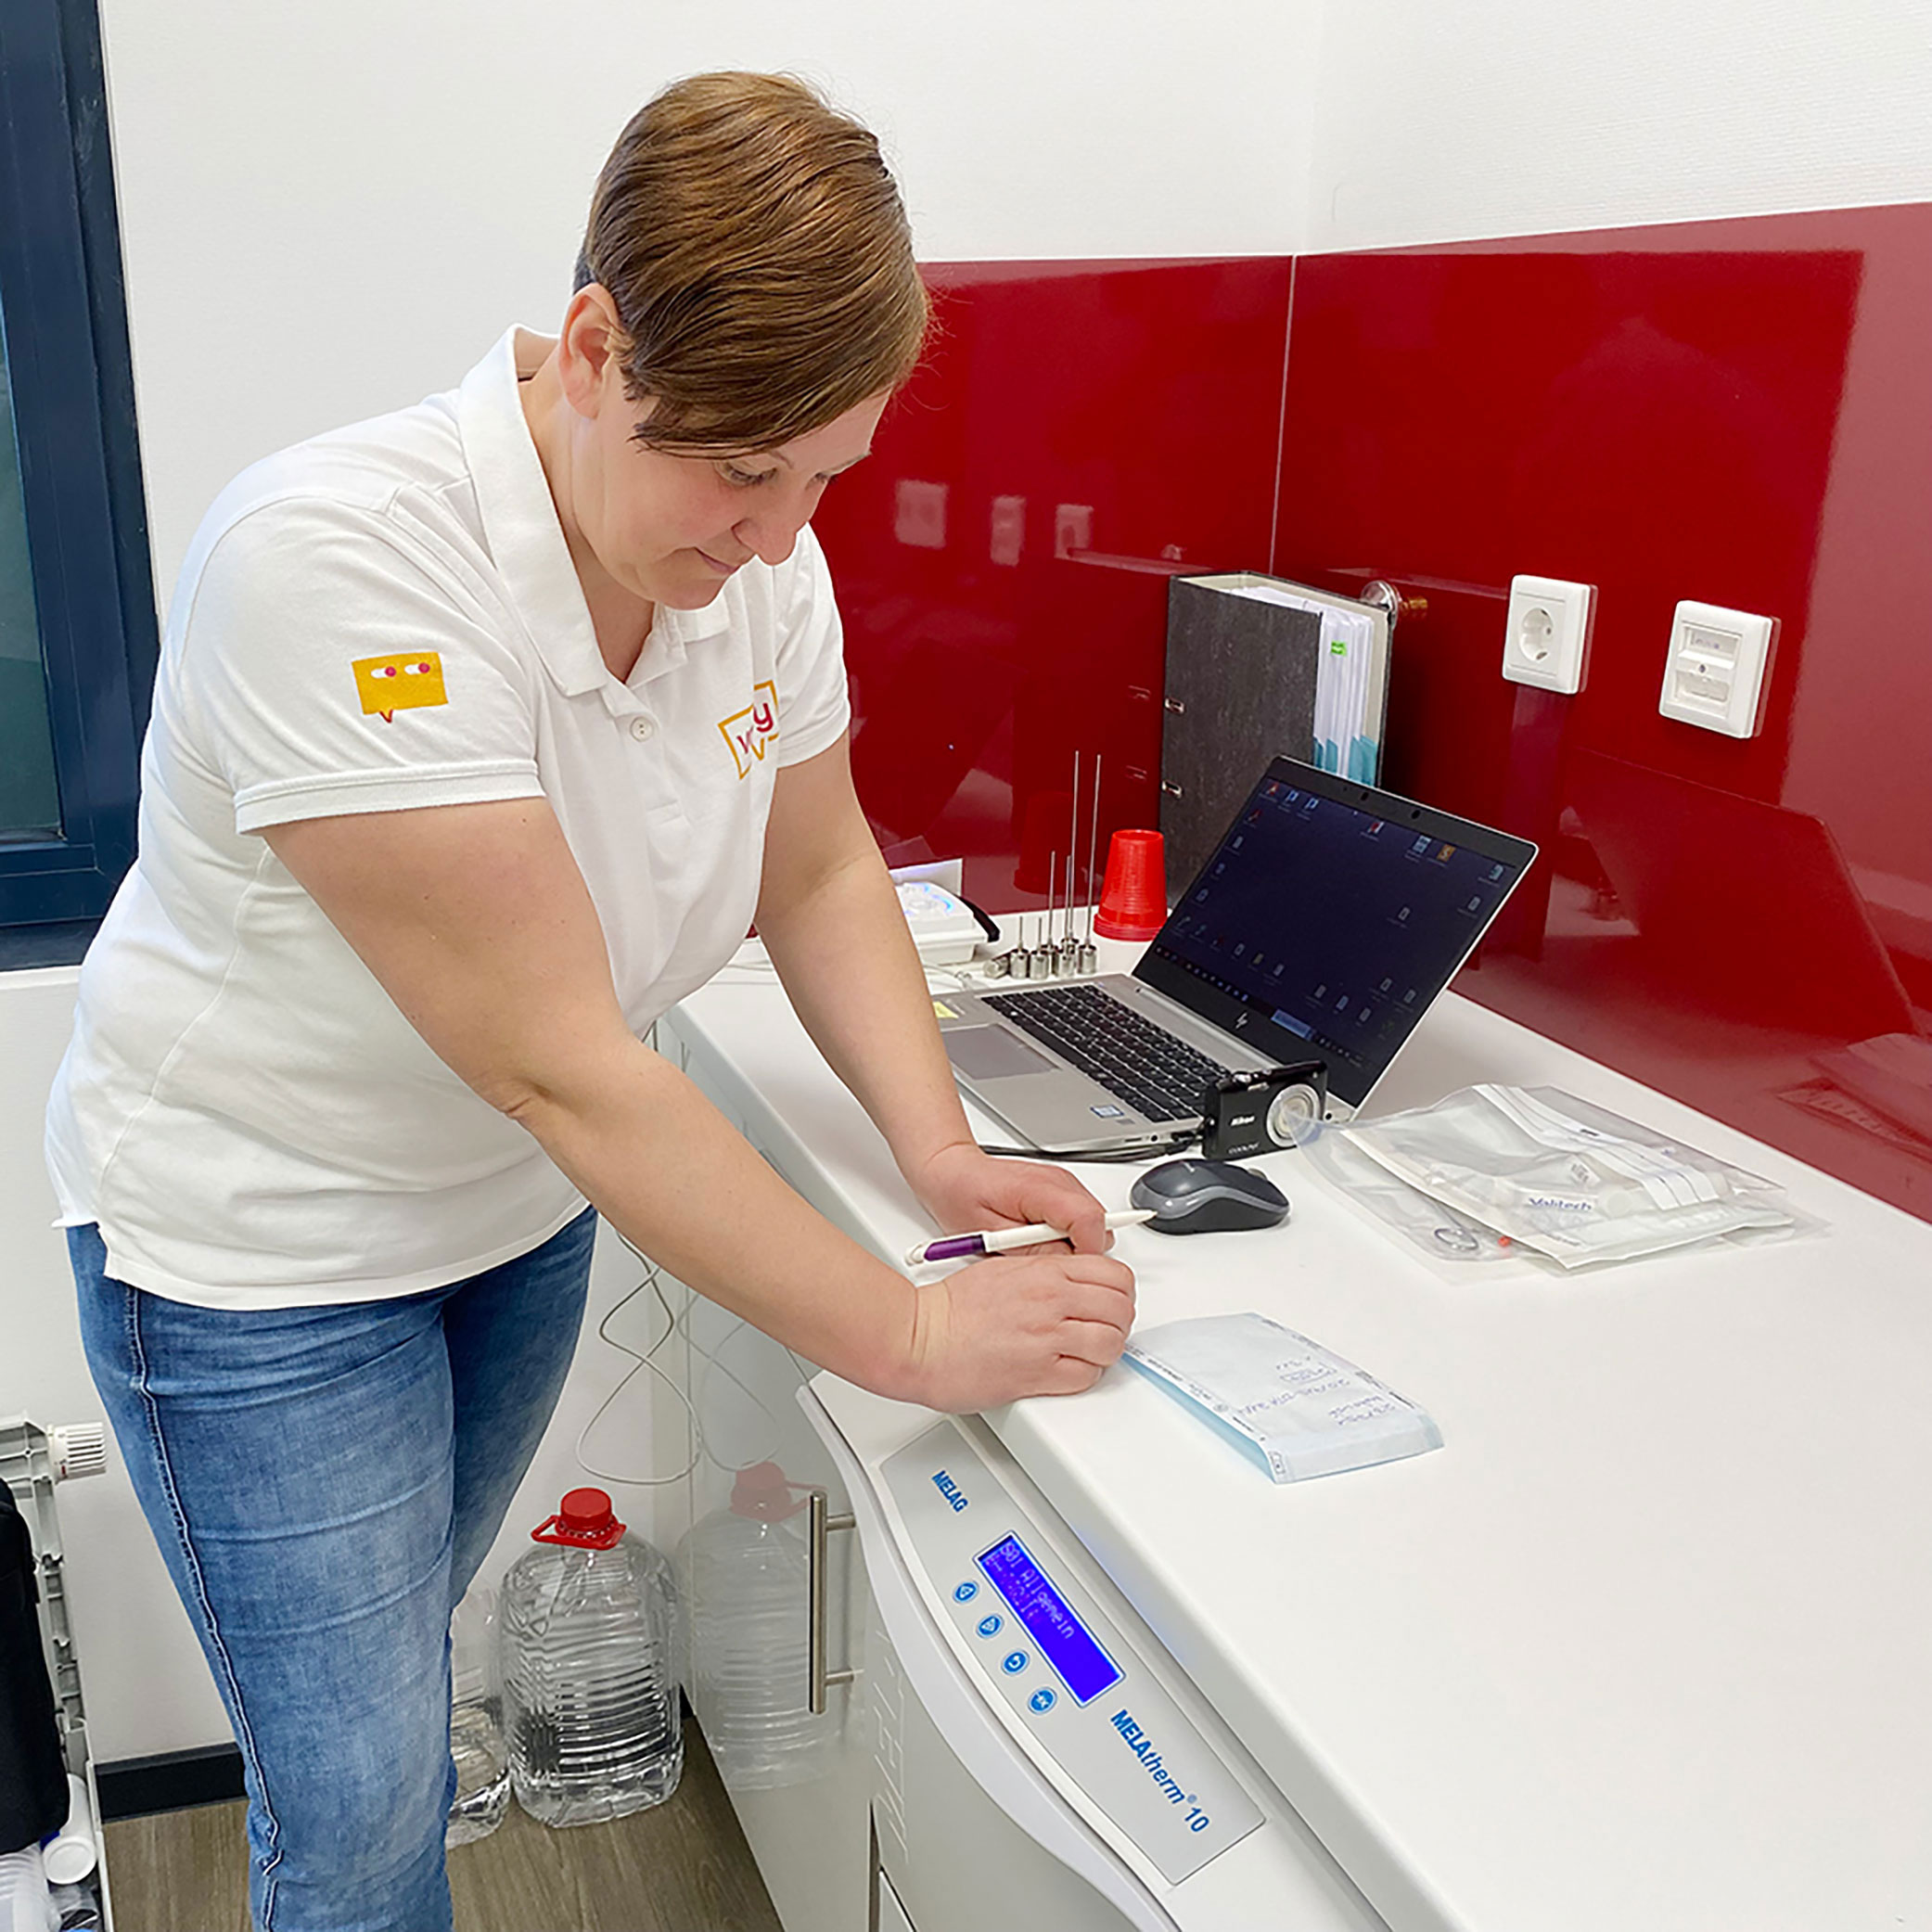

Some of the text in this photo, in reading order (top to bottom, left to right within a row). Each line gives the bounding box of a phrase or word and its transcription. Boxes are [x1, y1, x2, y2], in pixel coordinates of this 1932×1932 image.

[931, 1470, 968, 1513] MELAG
[1020, 1567, 1075, 1640] Allgemein
[1184, 1807, 1209, 1833] 10
